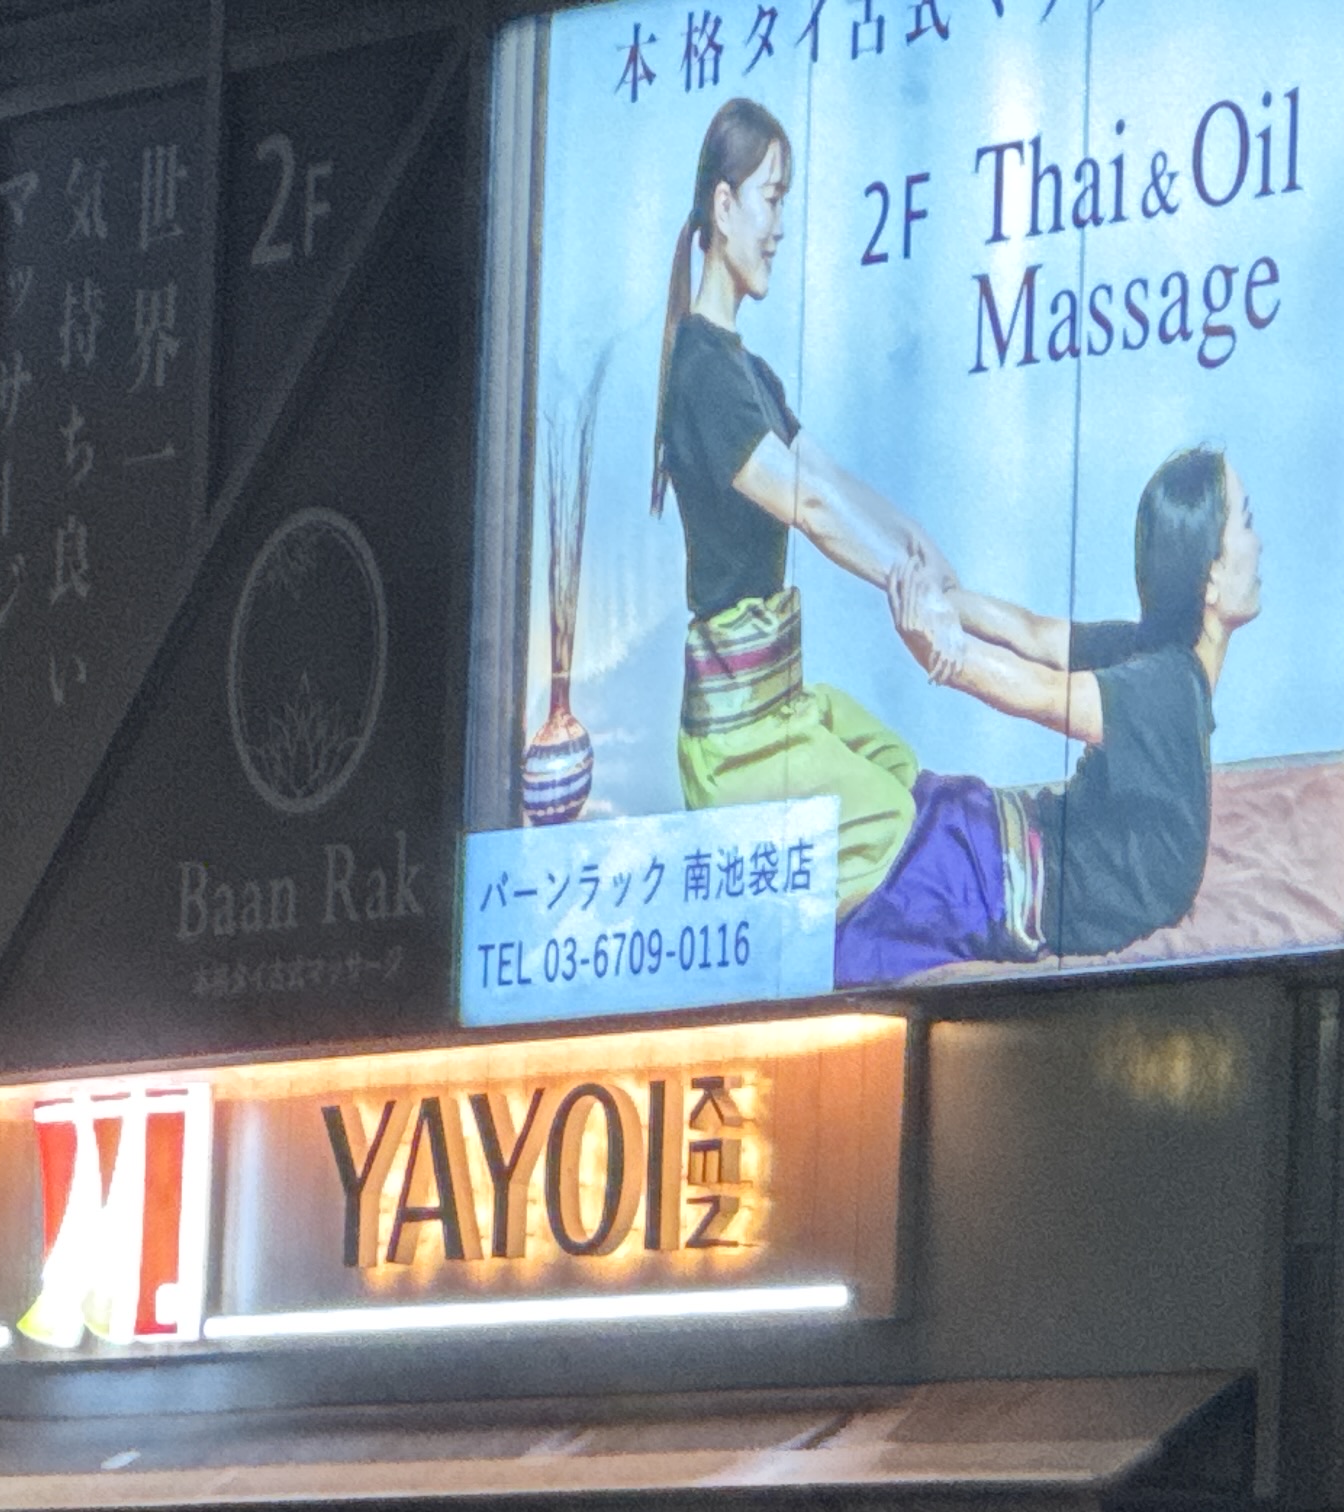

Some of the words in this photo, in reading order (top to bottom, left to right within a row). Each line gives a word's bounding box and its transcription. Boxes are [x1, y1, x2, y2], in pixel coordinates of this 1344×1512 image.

[250, 131, 333, 266] 2F
[860, 172, 931, 267] 2F
[121, 143, 188, 466] 世界一
[968, 253, 1282, 375] Massage
[49, 157, 109, 703] 気持ち良い
[176, 860, 299, 942] Baan
[321, 829, 425, 924] Rak
[478, 941, 532, 988] TEL
[543, 919, 751, 983] 03-6709-0116
[320, 1079, 672, 1269] YAYOI
[685, 1074, 744, 1250] KEN
